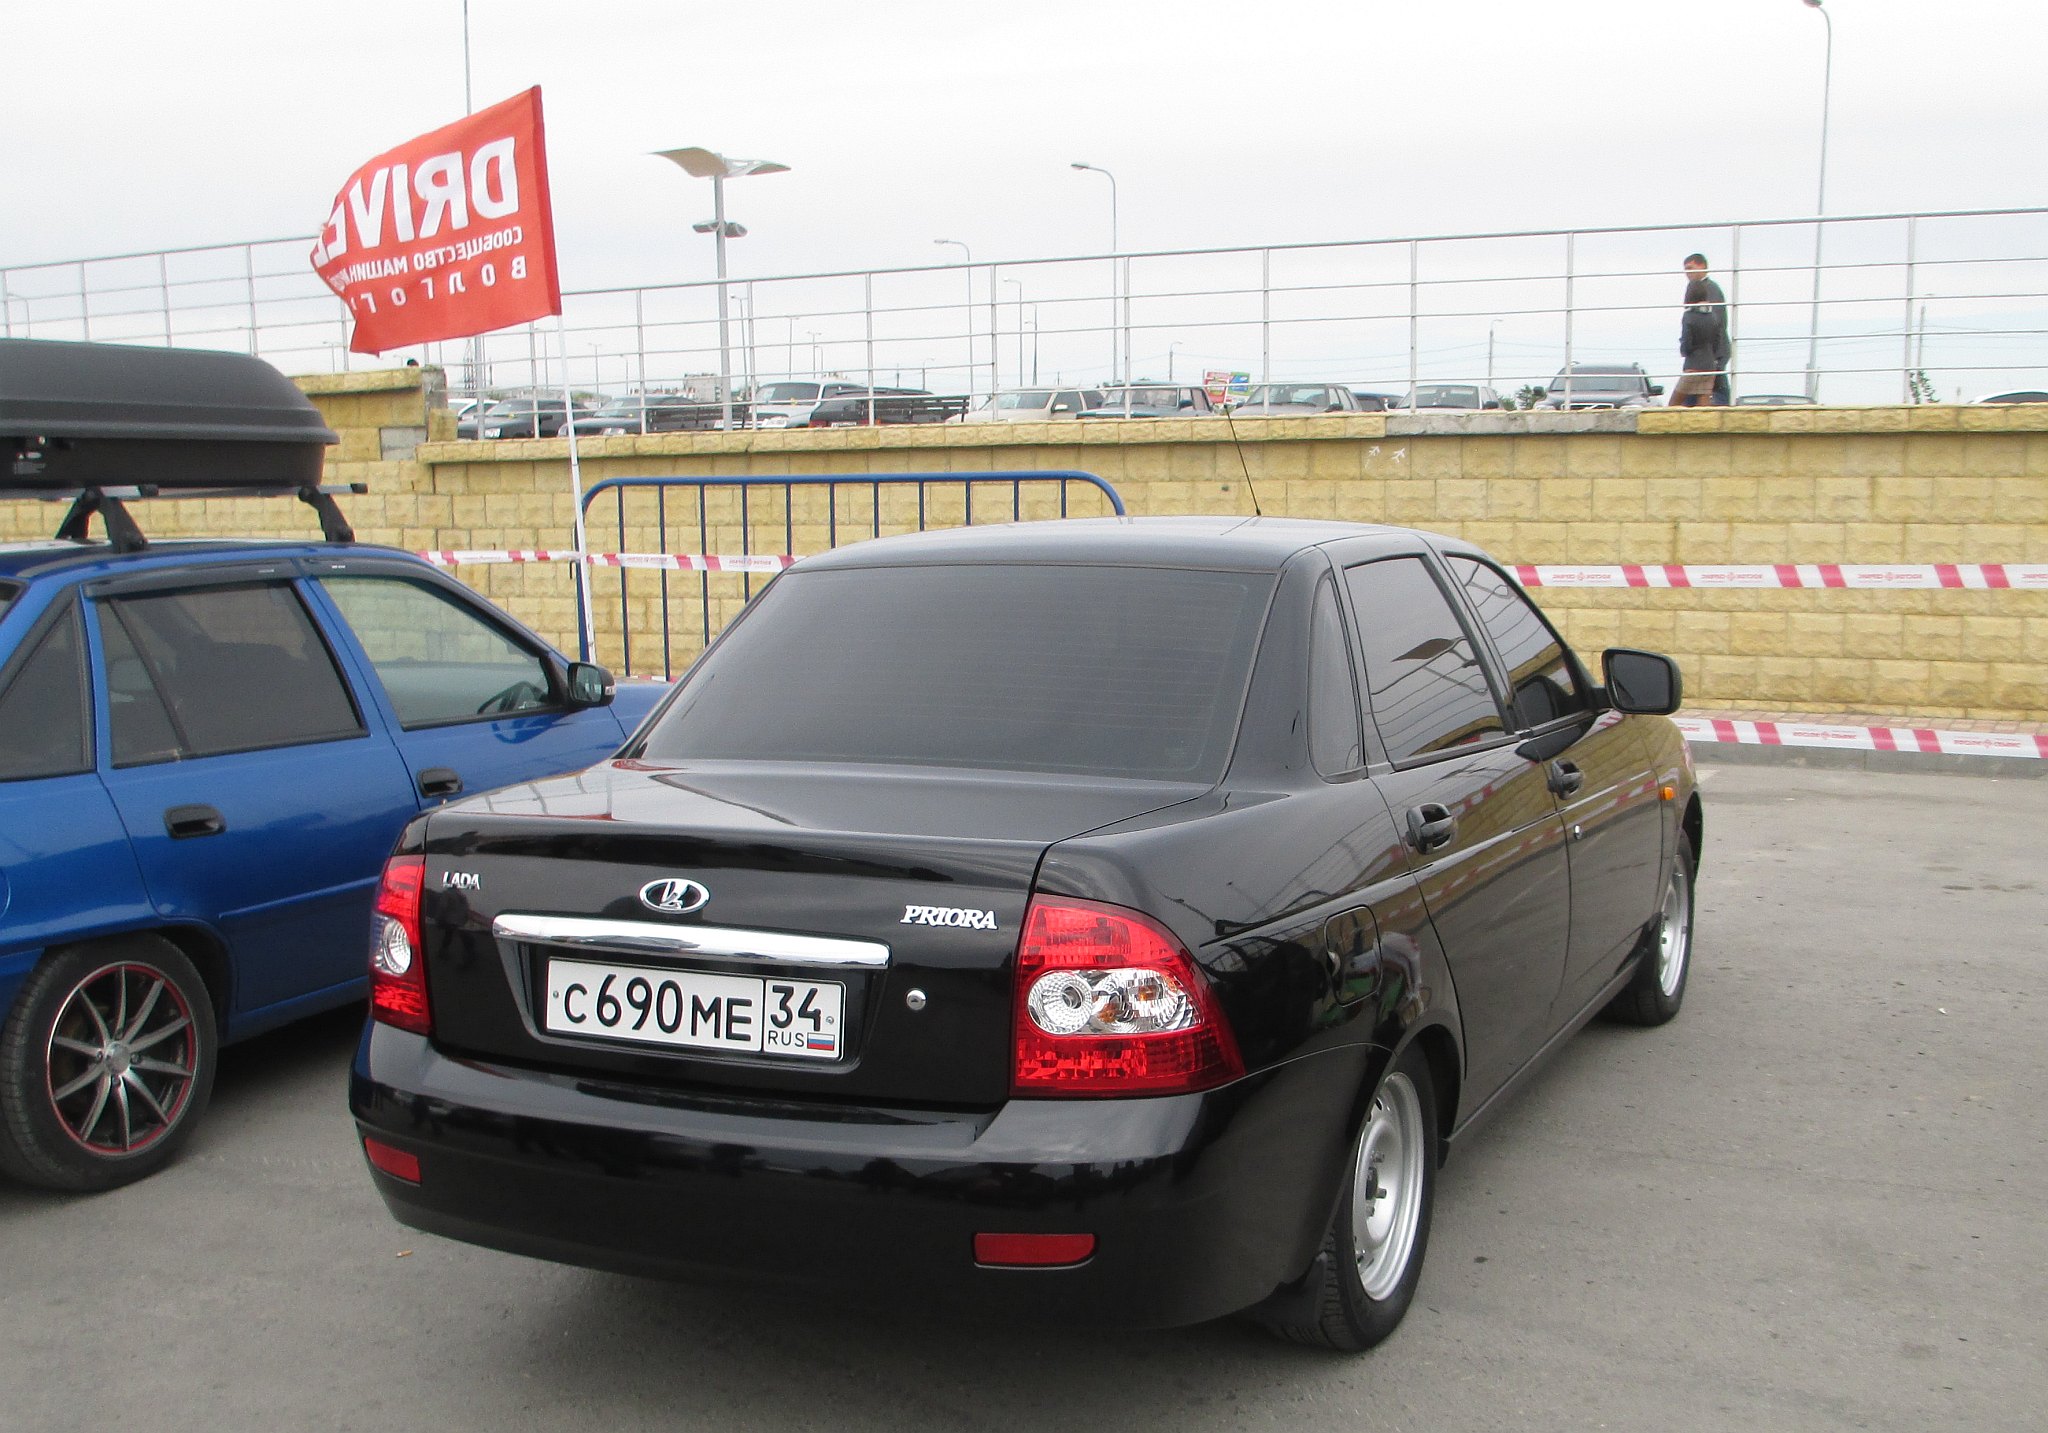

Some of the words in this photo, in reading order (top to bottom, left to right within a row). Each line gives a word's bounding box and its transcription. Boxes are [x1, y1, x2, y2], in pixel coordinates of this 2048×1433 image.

[442, 871, 481, 890] LADA
[900, 904, 998, 930] PRIORA
[564, 973, 753, 1042] С690МЕ
[770, 984, 822, 1032] 34
[768, 1030, 805, 1048] RUS
